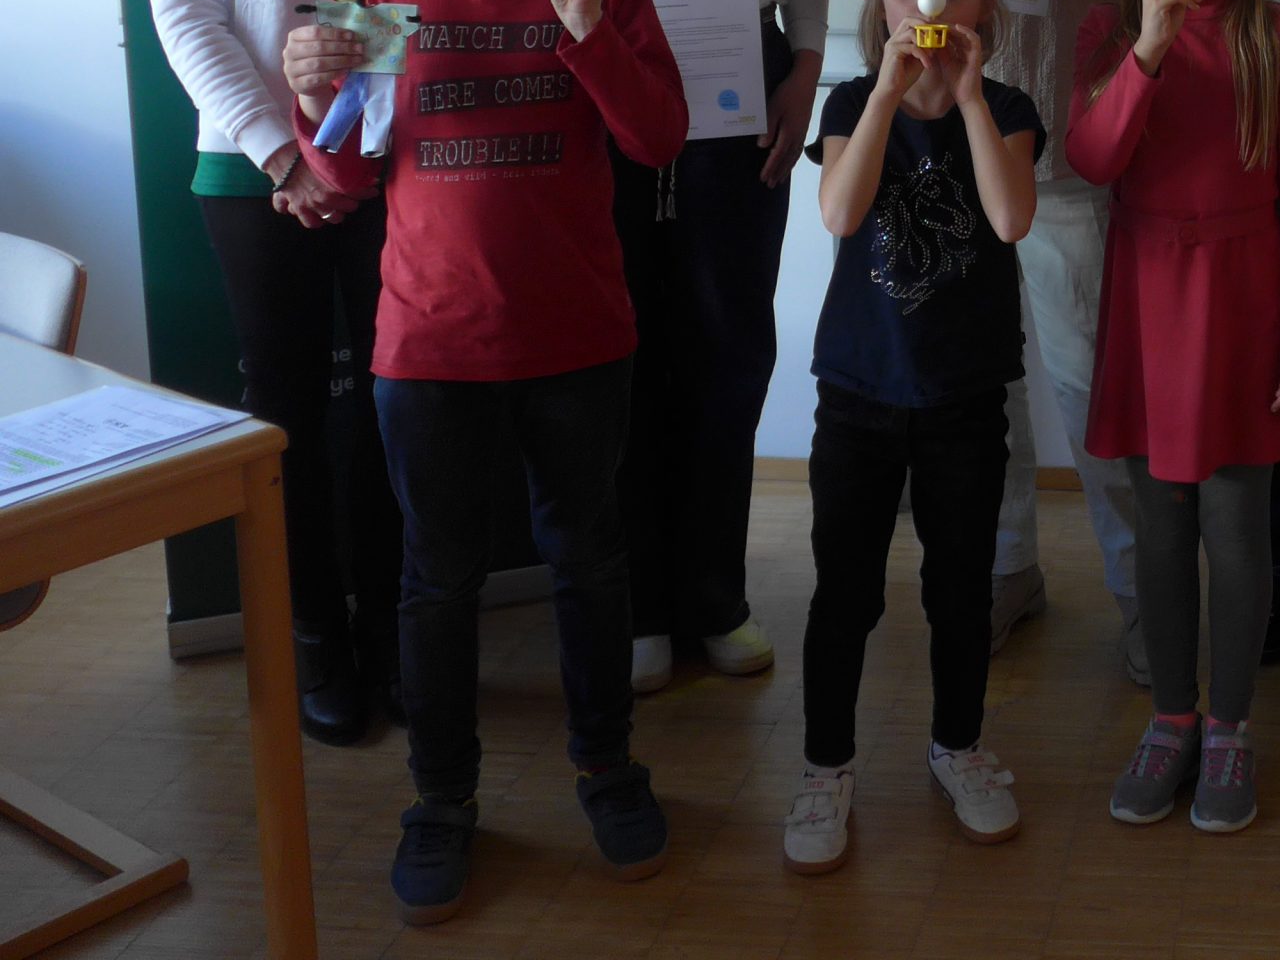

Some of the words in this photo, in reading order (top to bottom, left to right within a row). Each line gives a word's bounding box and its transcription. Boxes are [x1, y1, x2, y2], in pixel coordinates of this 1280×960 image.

[419, 24, 505, 50] WATCH
[419, 81, 476, 112] HERE
[494, 74, 571, 105] COMES
[420, 134, 563, 167] TROUBLE!!!
